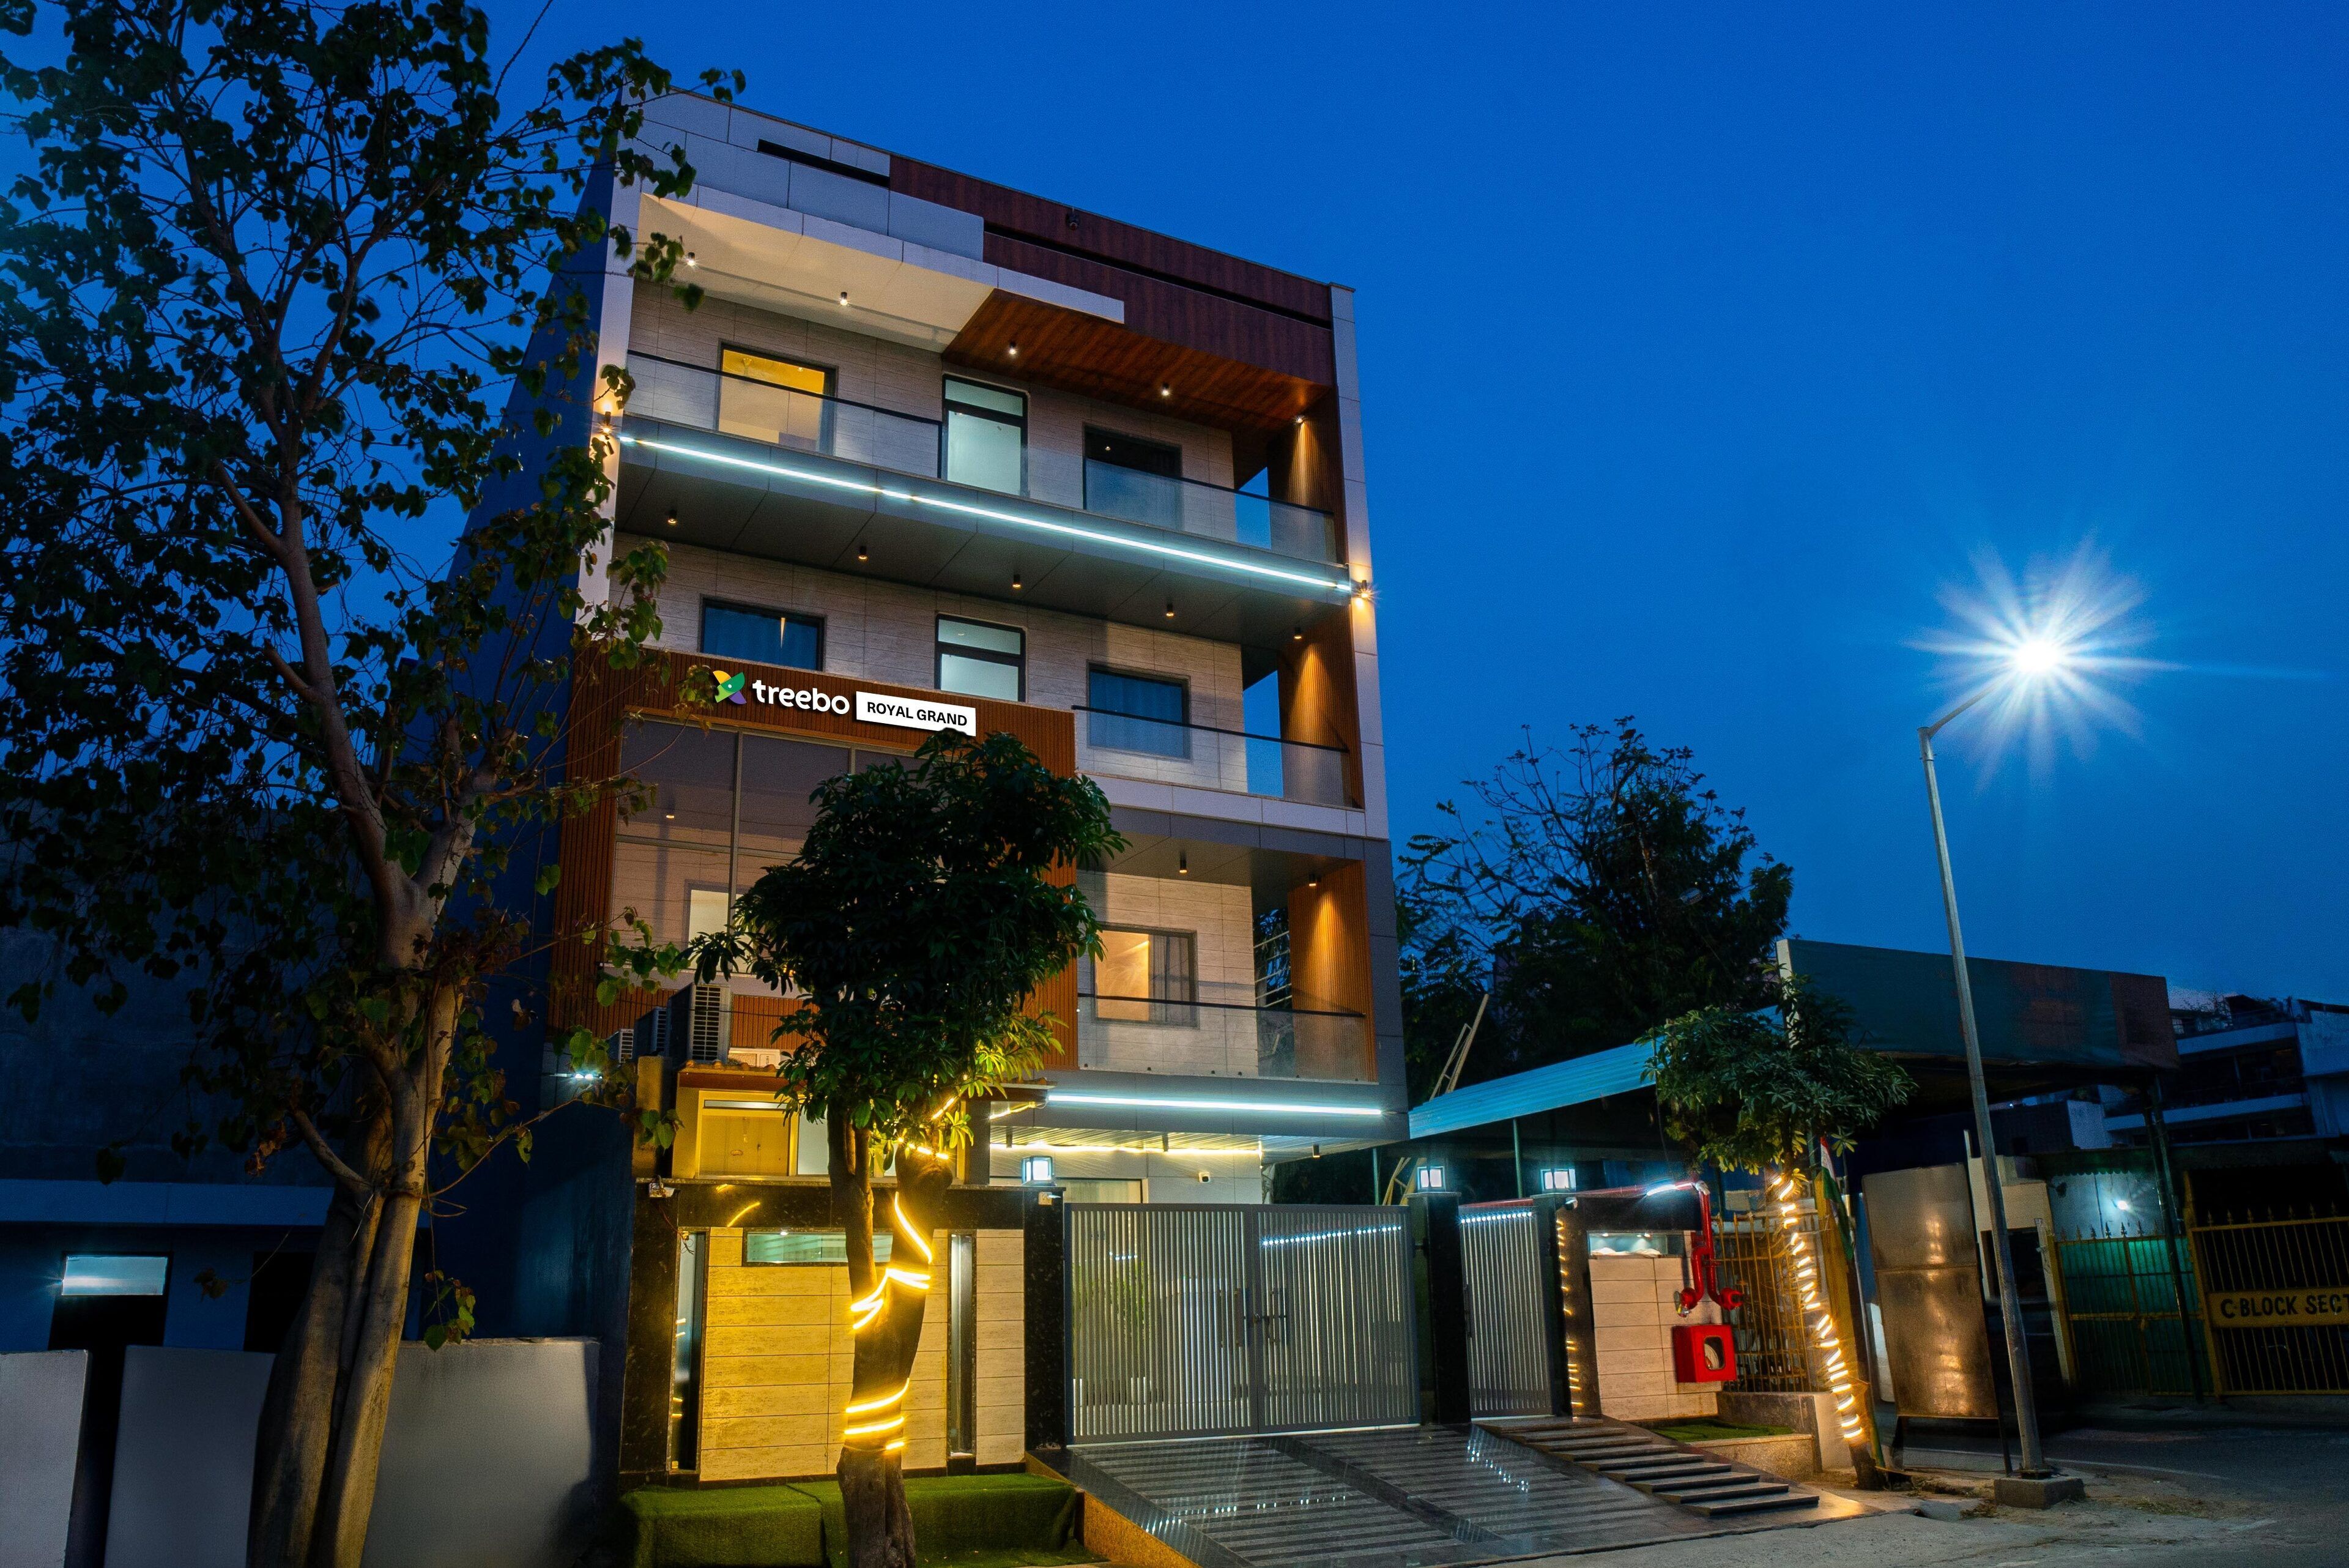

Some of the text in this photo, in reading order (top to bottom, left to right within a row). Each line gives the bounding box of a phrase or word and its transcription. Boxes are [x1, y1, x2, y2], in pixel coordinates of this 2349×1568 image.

[752, 680, 850, 715] treebo
[867, 702, 967, 726] ROYAL GRAND
